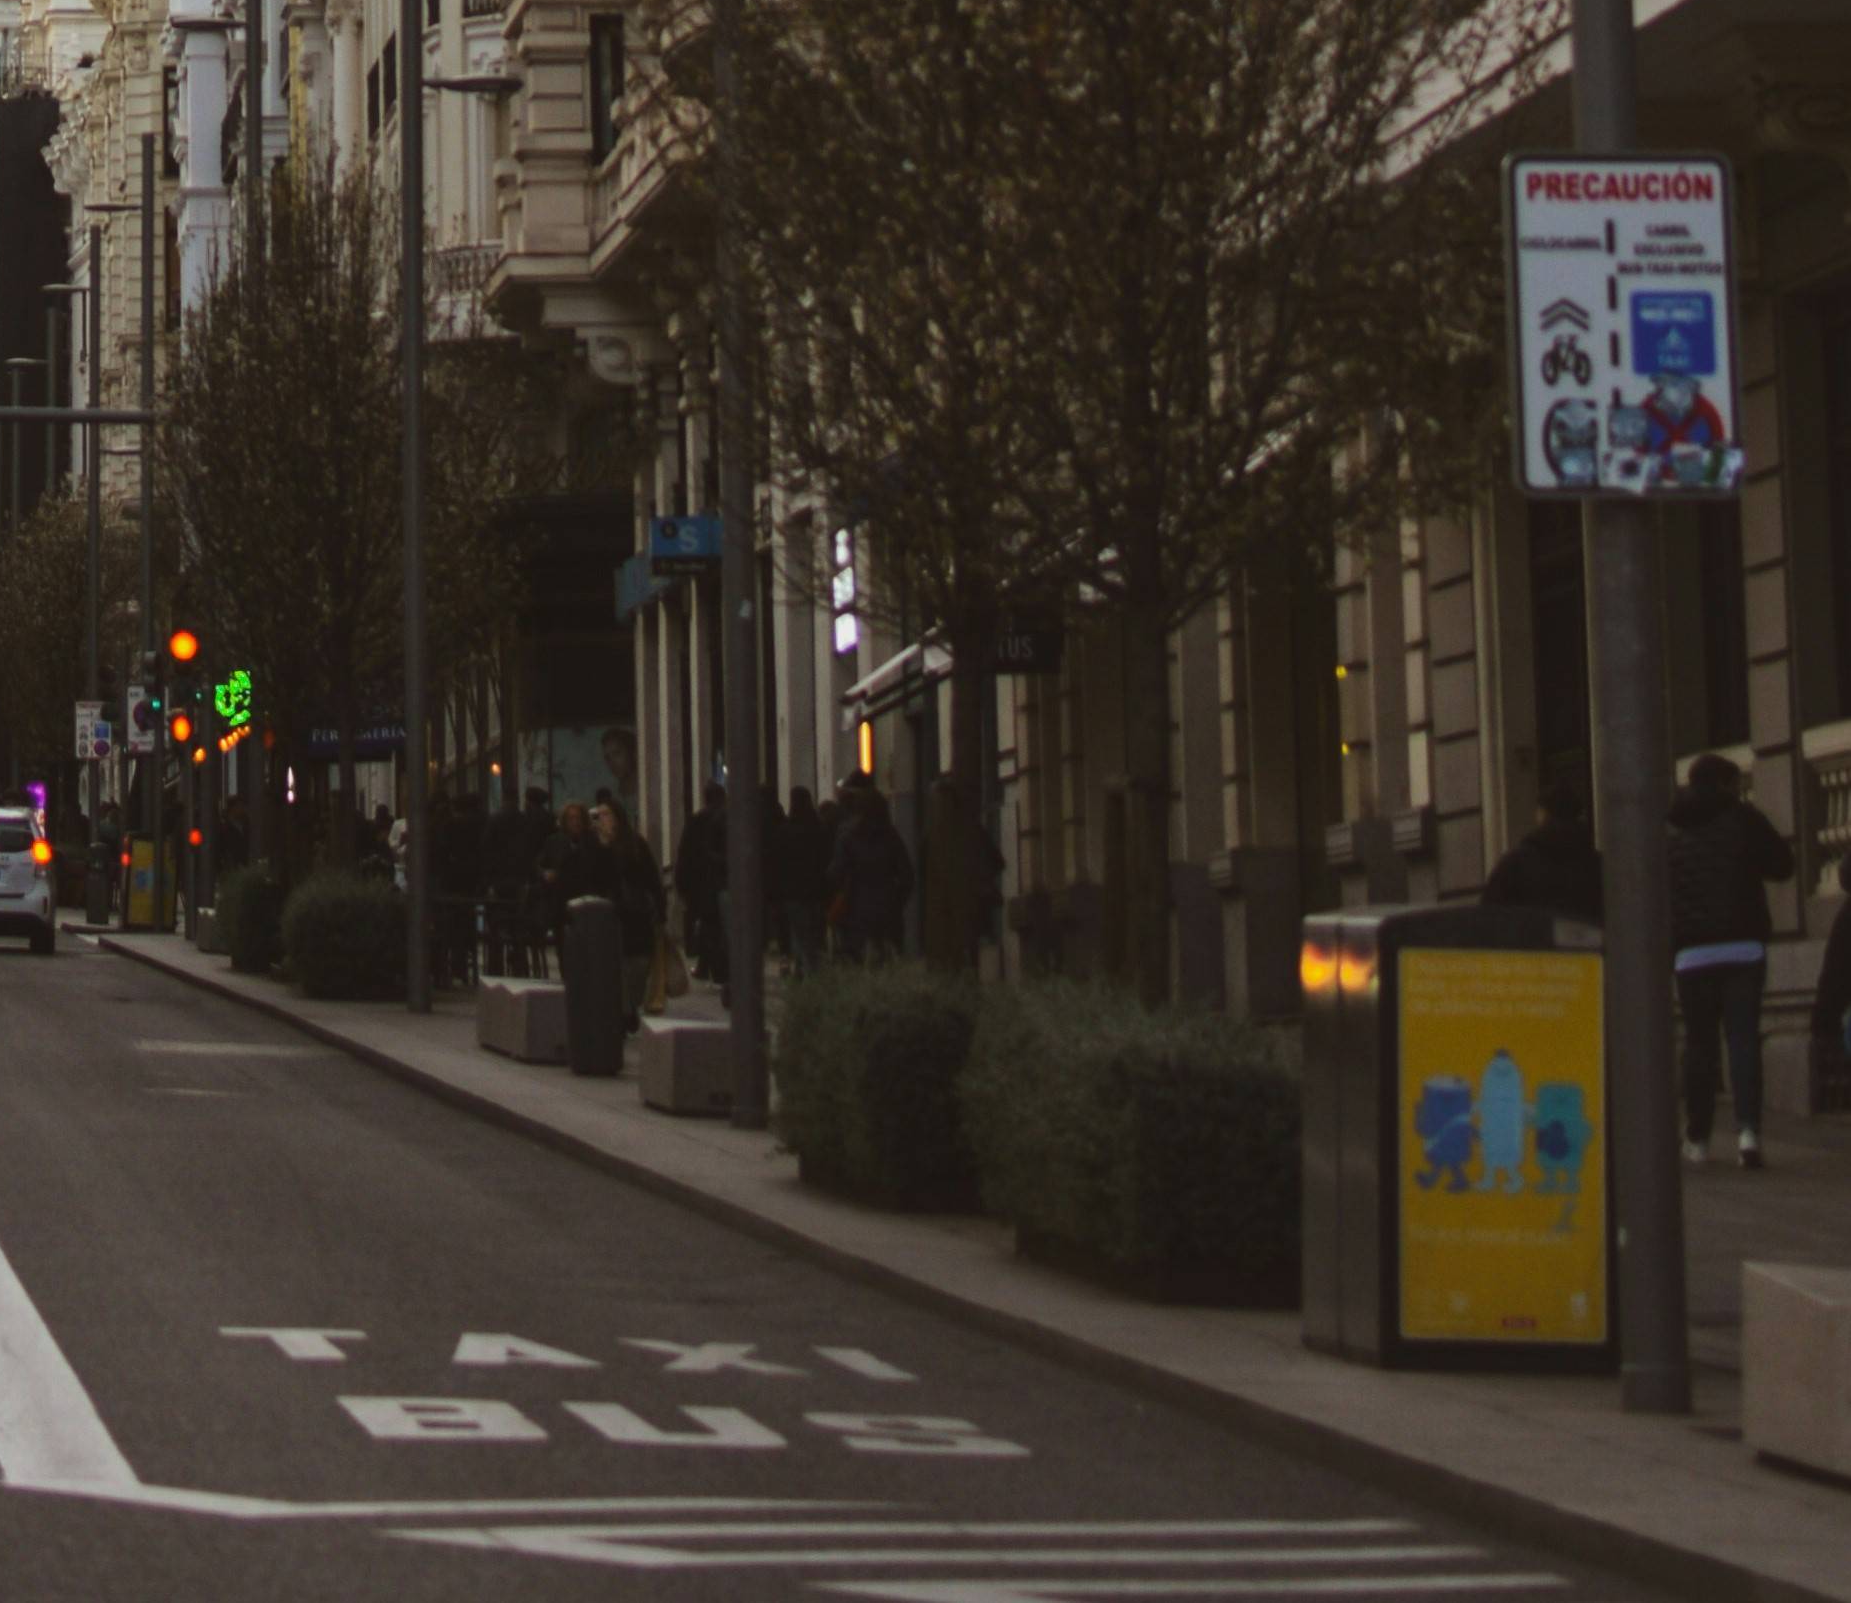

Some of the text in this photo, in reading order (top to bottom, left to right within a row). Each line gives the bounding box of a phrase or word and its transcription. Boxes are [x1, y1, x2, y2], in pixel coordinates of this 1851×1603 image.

[1526, 166, 1714, 201] PRECAUCIÓN
[218, 1326, 918, 1382] TAXI
[336, 1395, 1034, 1457] BUS
